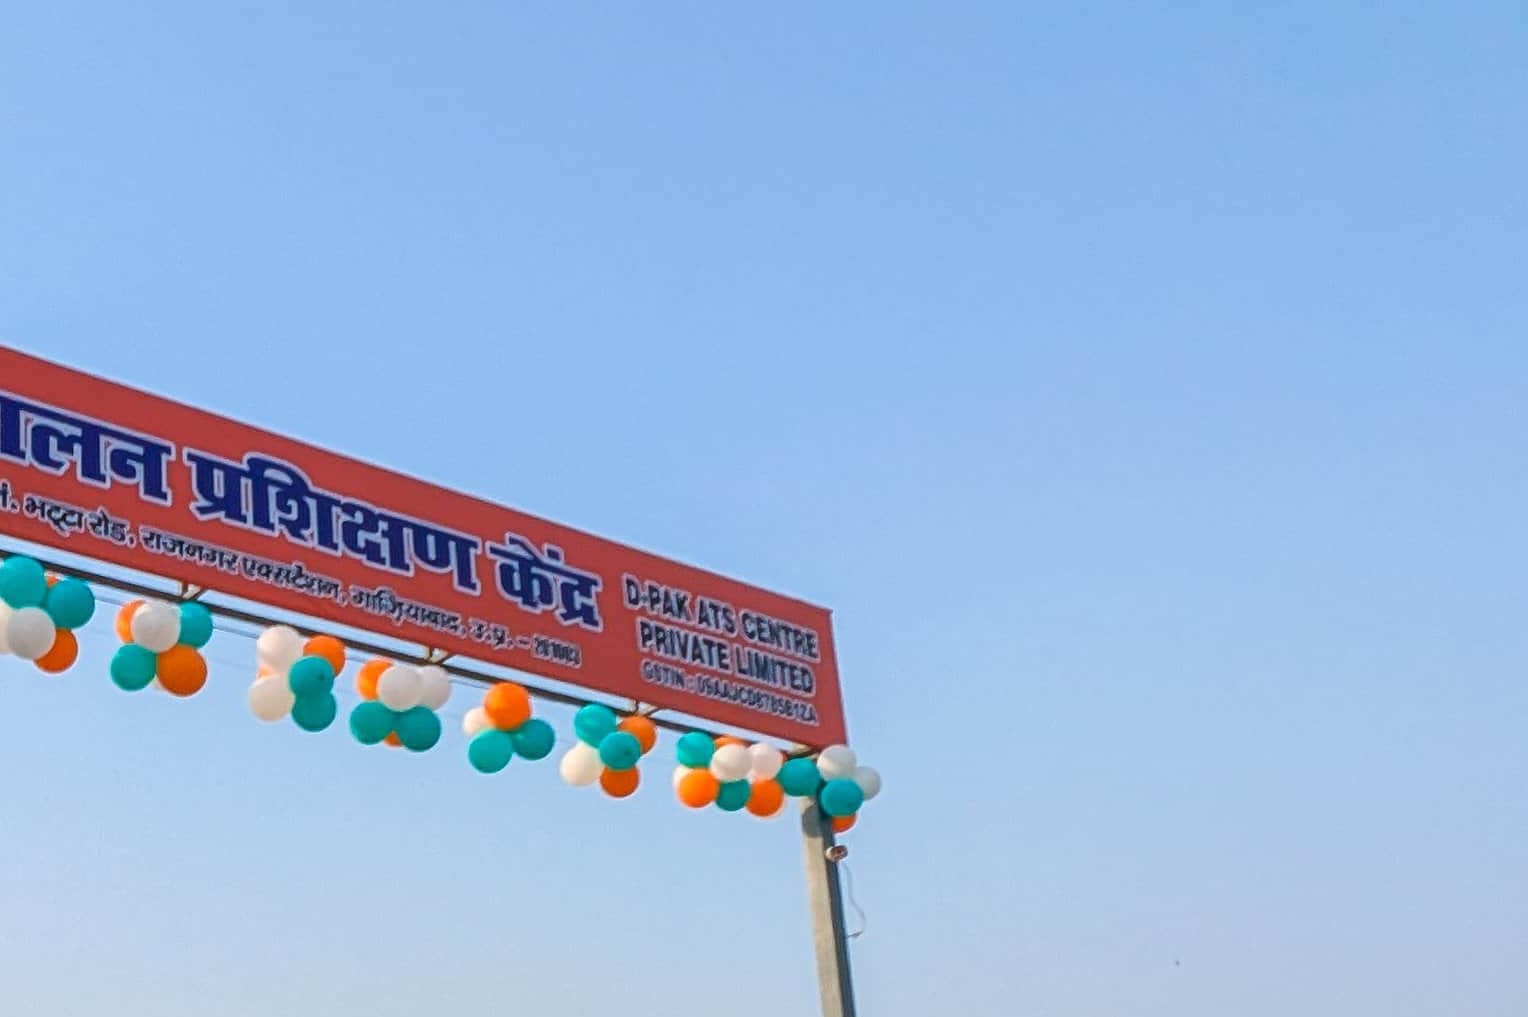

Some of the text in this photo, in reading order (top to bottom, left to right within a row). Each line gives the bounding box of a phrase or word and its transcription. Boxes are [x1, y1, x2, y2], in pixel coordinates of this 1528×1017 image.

[140, 527, 239, 574] राजनगर
[186, 454, 479, 594] प्रशिक्षण
[487, 534, 602, 630] केंद्र
[624, 574, 820, 662] D-PAK ATS CENTRE
[638, 618, 815, 697] PRIVATE LIMITED
